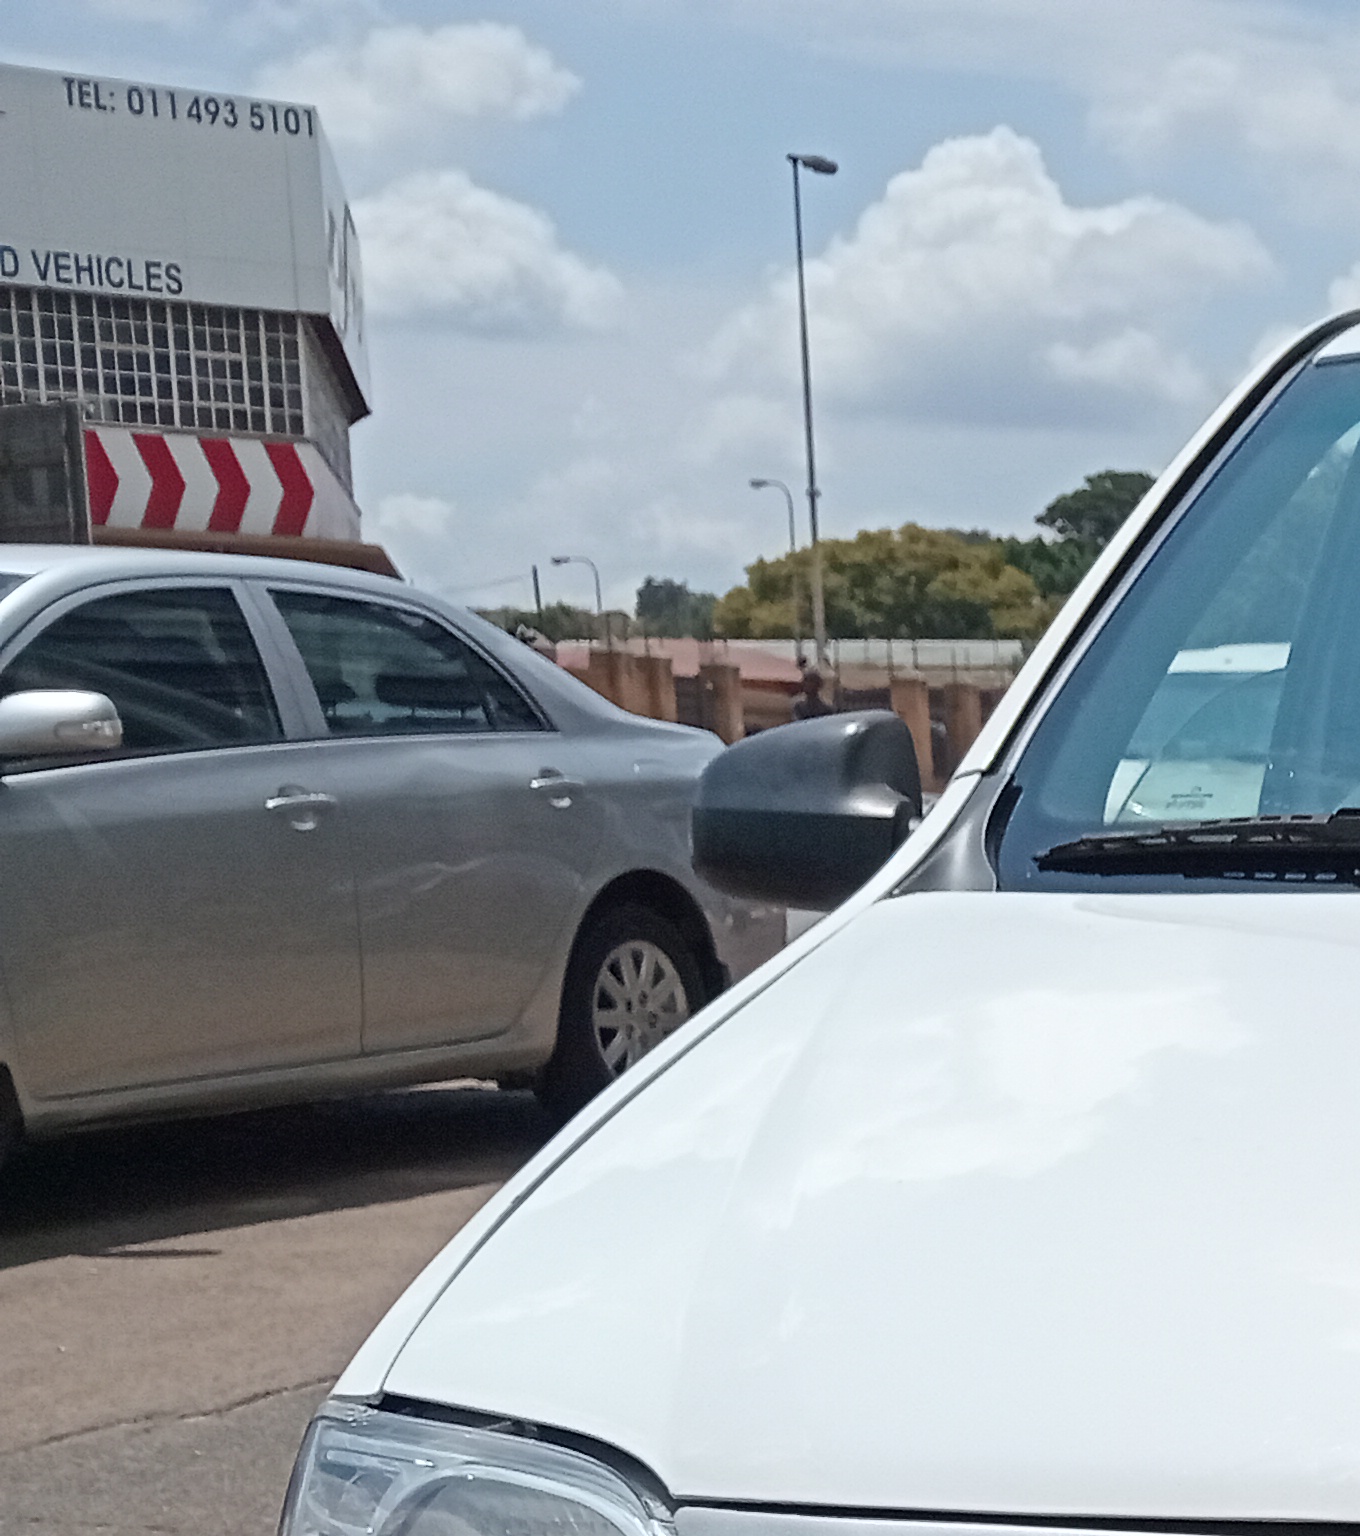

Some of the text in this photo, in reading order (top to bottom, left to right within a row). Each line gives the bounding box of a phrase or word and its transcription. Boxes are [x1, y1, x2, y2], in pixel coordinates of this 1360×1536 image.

[62, 76, 316, 138] TEL: 011 493 5101
[30, 248, 184, 296] VEHICLES
